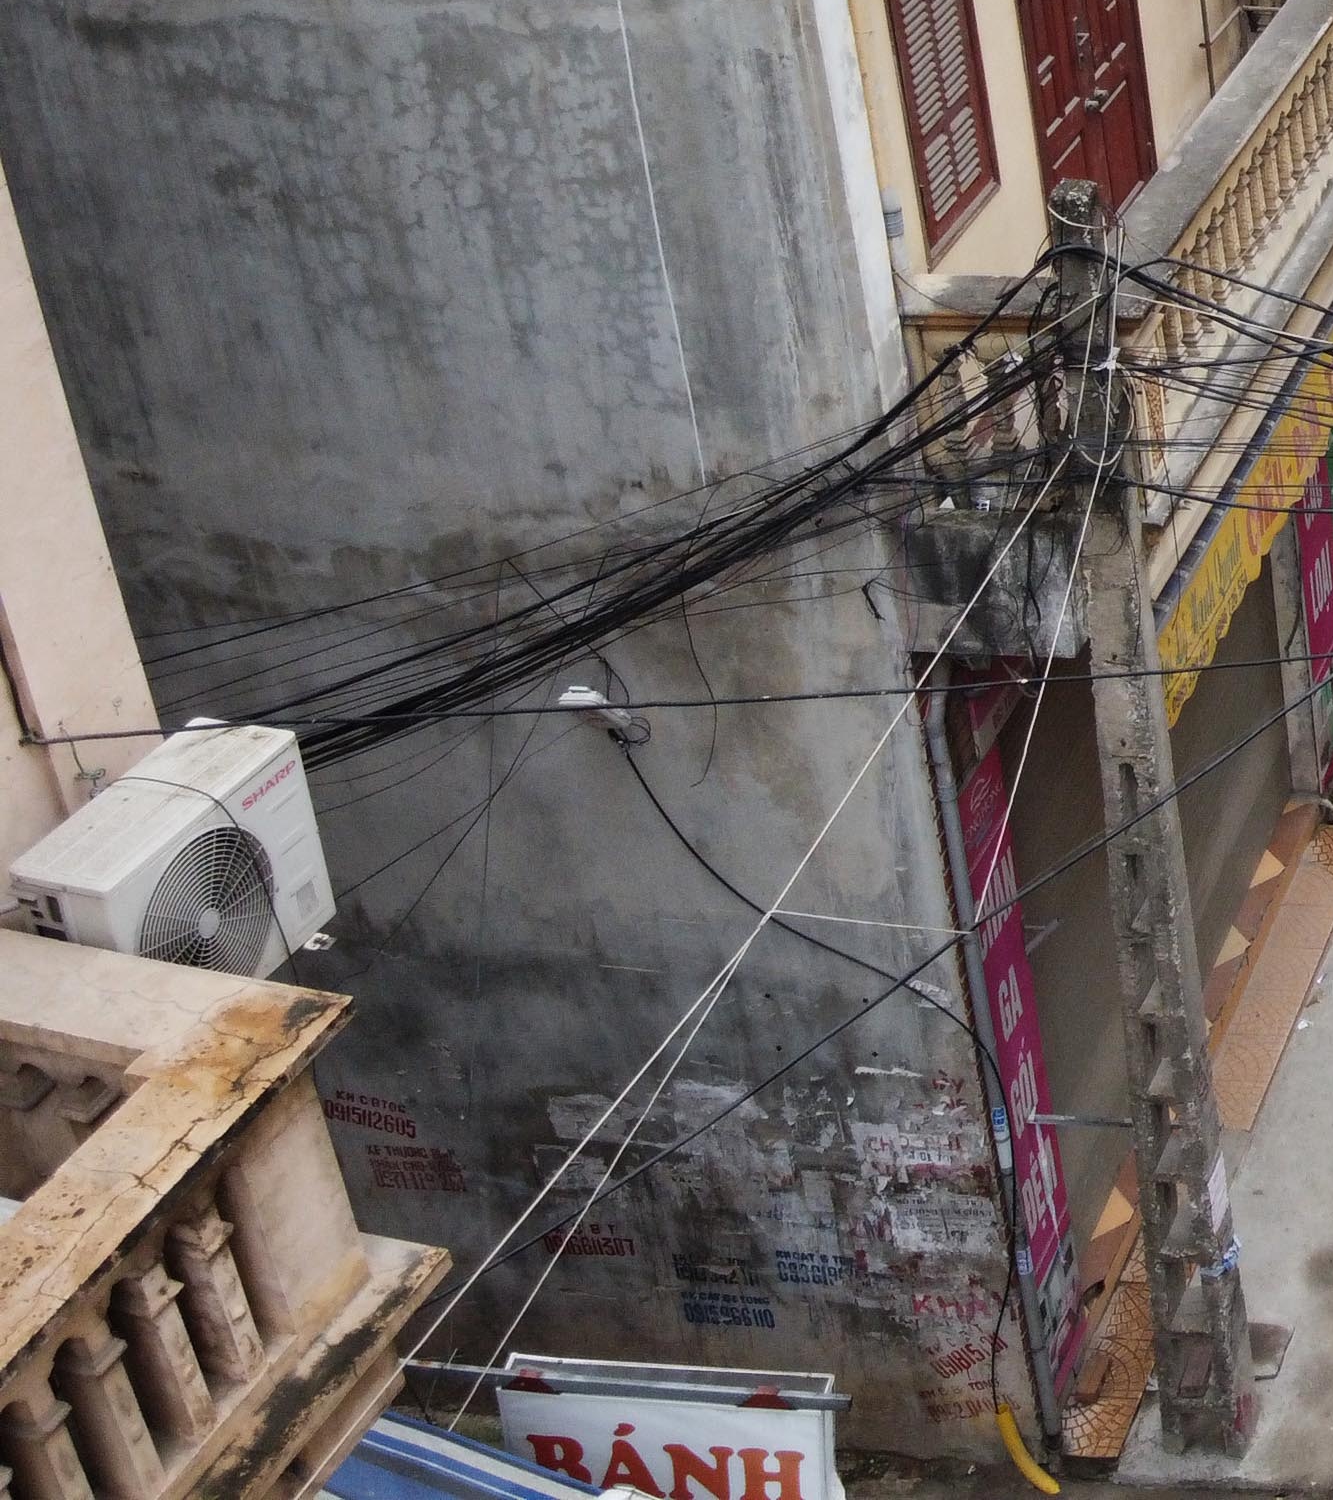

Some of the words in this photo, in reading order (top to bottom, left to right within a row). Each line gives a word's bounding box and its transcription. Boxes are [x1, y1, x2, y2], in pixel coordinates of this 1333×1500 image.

[241, 759, 297, 812] SHARP
[998, 963, 1024, 1043] GA
[323, 1099, 417, 1140] 0915112605
[1010, 1036, 1039, 1140] GỐI
[526, 1422, 806, 1500] BÁNH
